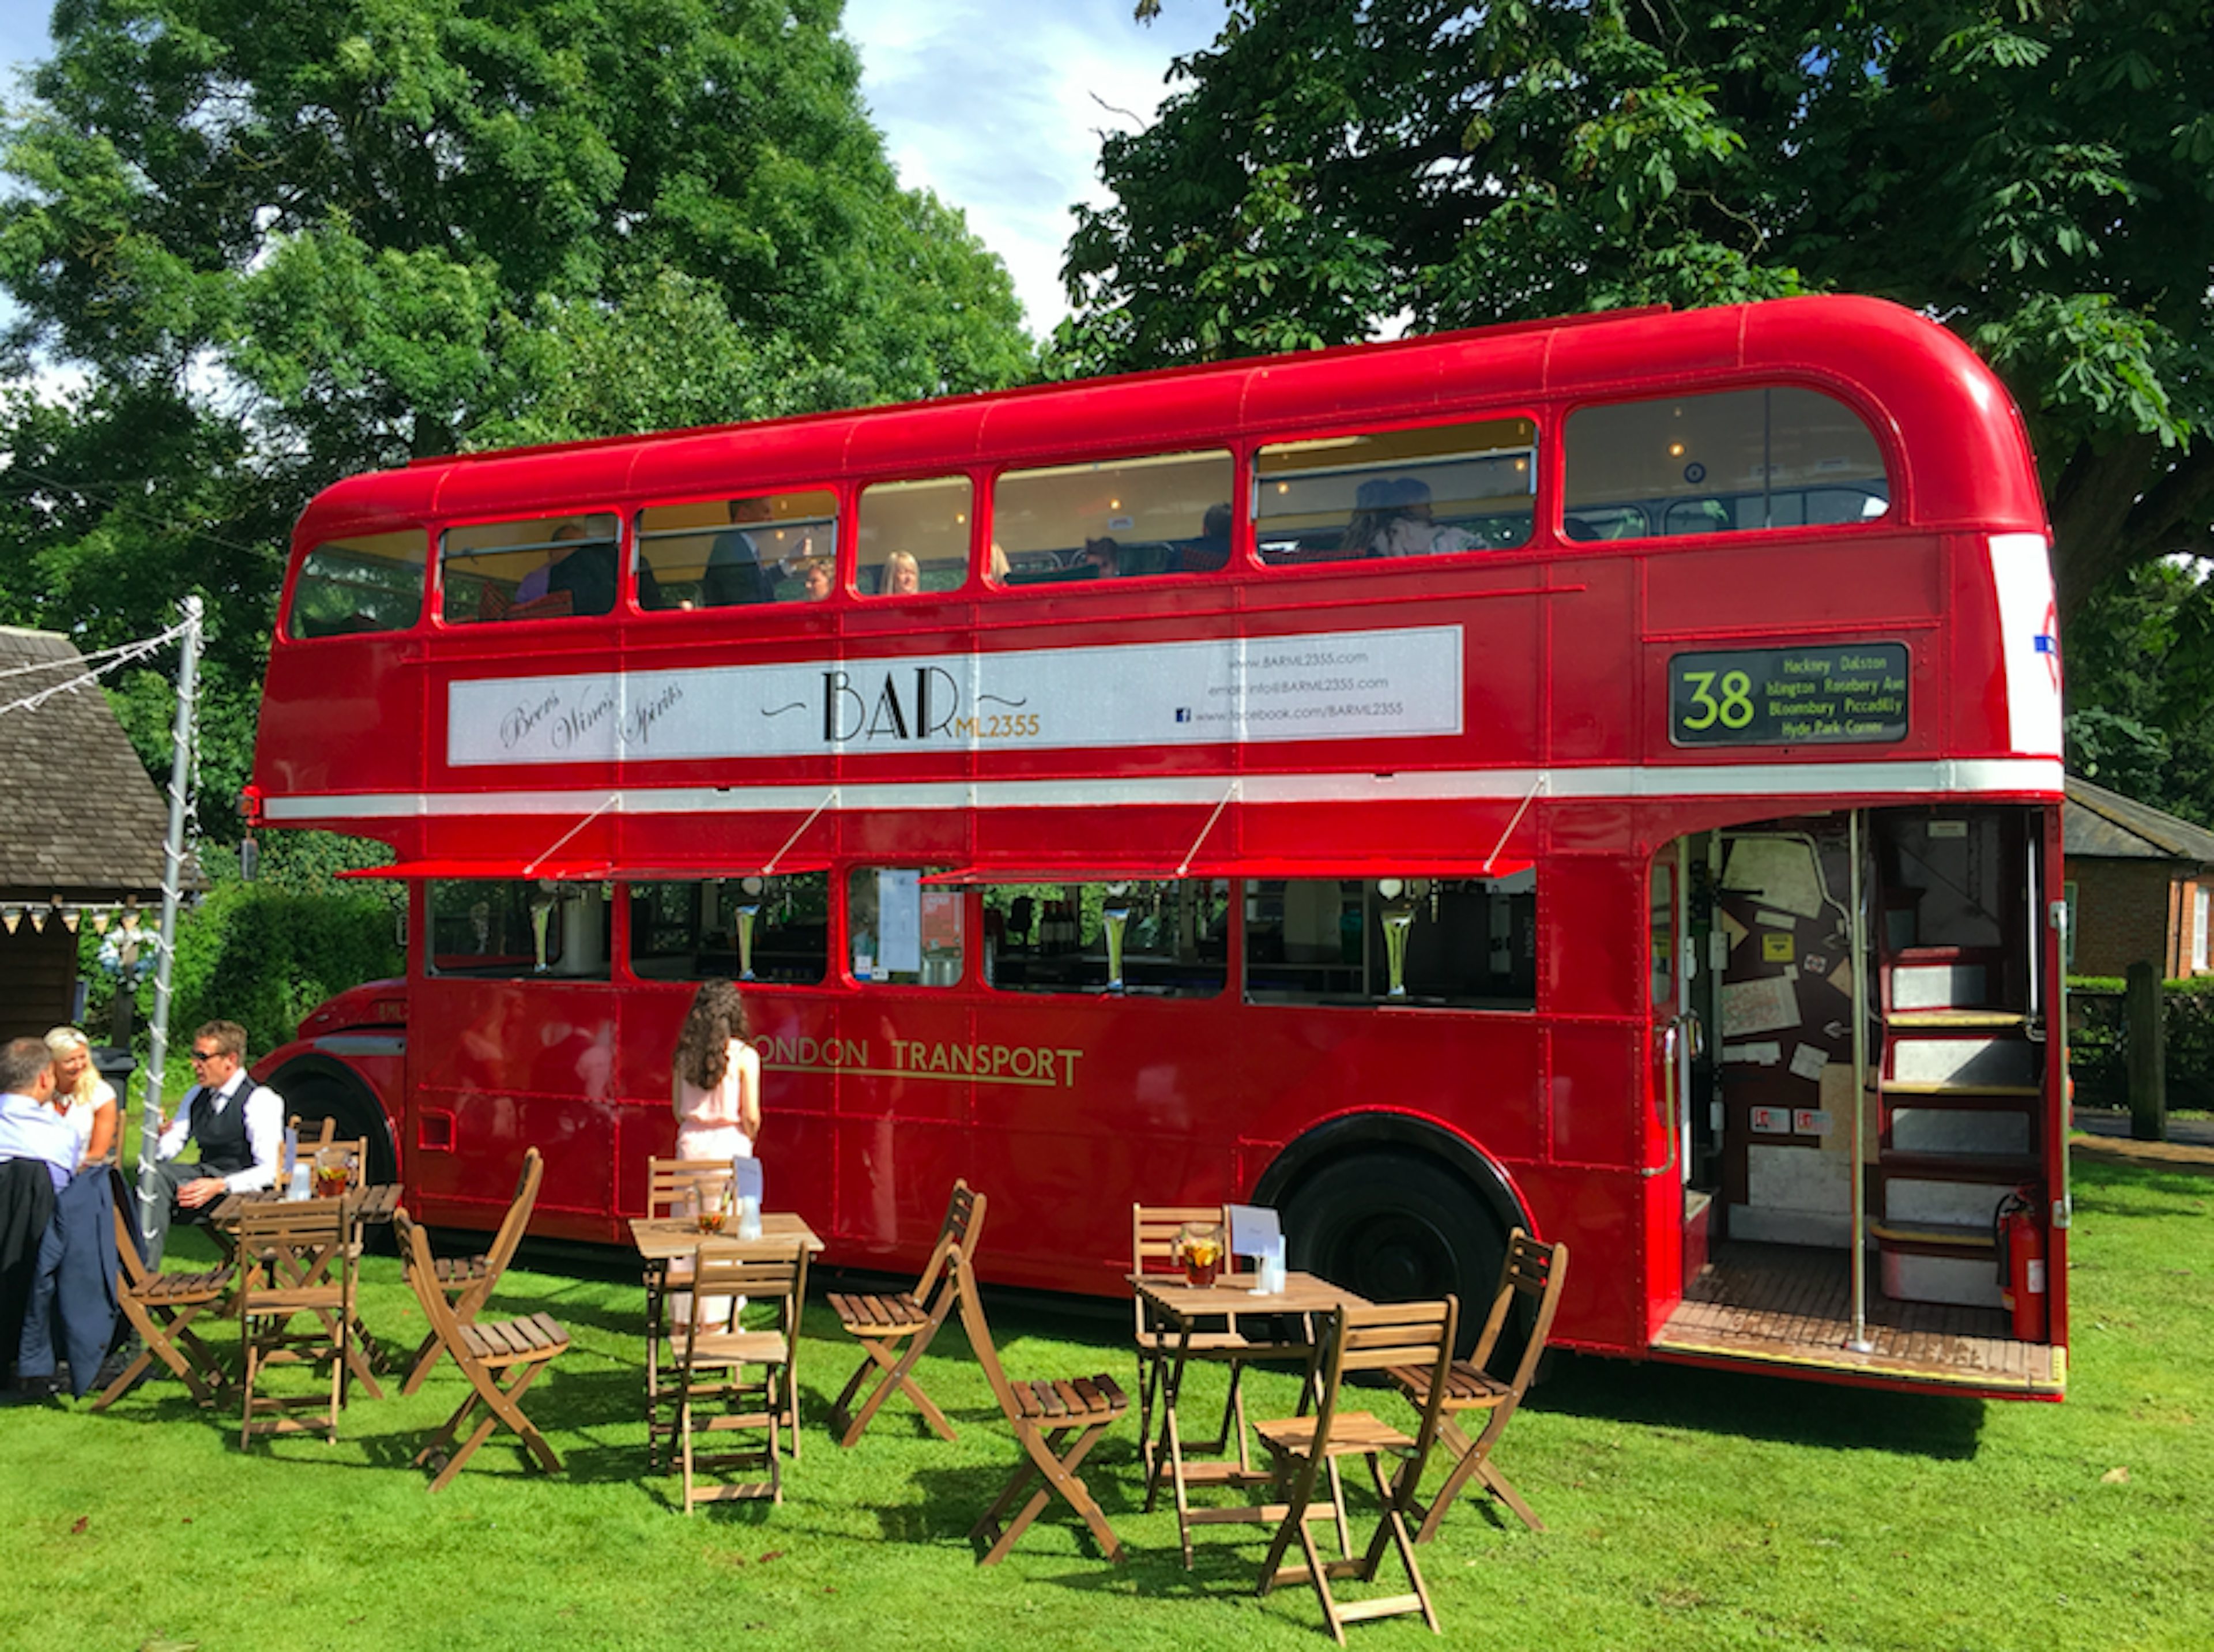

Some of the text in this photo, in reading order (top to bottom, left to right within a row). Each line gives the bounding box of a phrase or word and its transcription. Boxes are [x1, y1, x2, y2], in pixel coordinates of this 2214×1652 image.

[1783, 656, 1887, 675] Hackney Dalston
[500, 680, 684, 750] Beers Wines Spirits
[822, 667, 1040, 742] BAR ML2355
[1683, 670, 1754, 729] 38
[1769, 697, 1903, 717] Bloomsbury Piccadilly
[1782, 720, 1884, 740] Hyde Park Corner
[752, 1035, 1083, 1086] ONDON TRANSPORT
